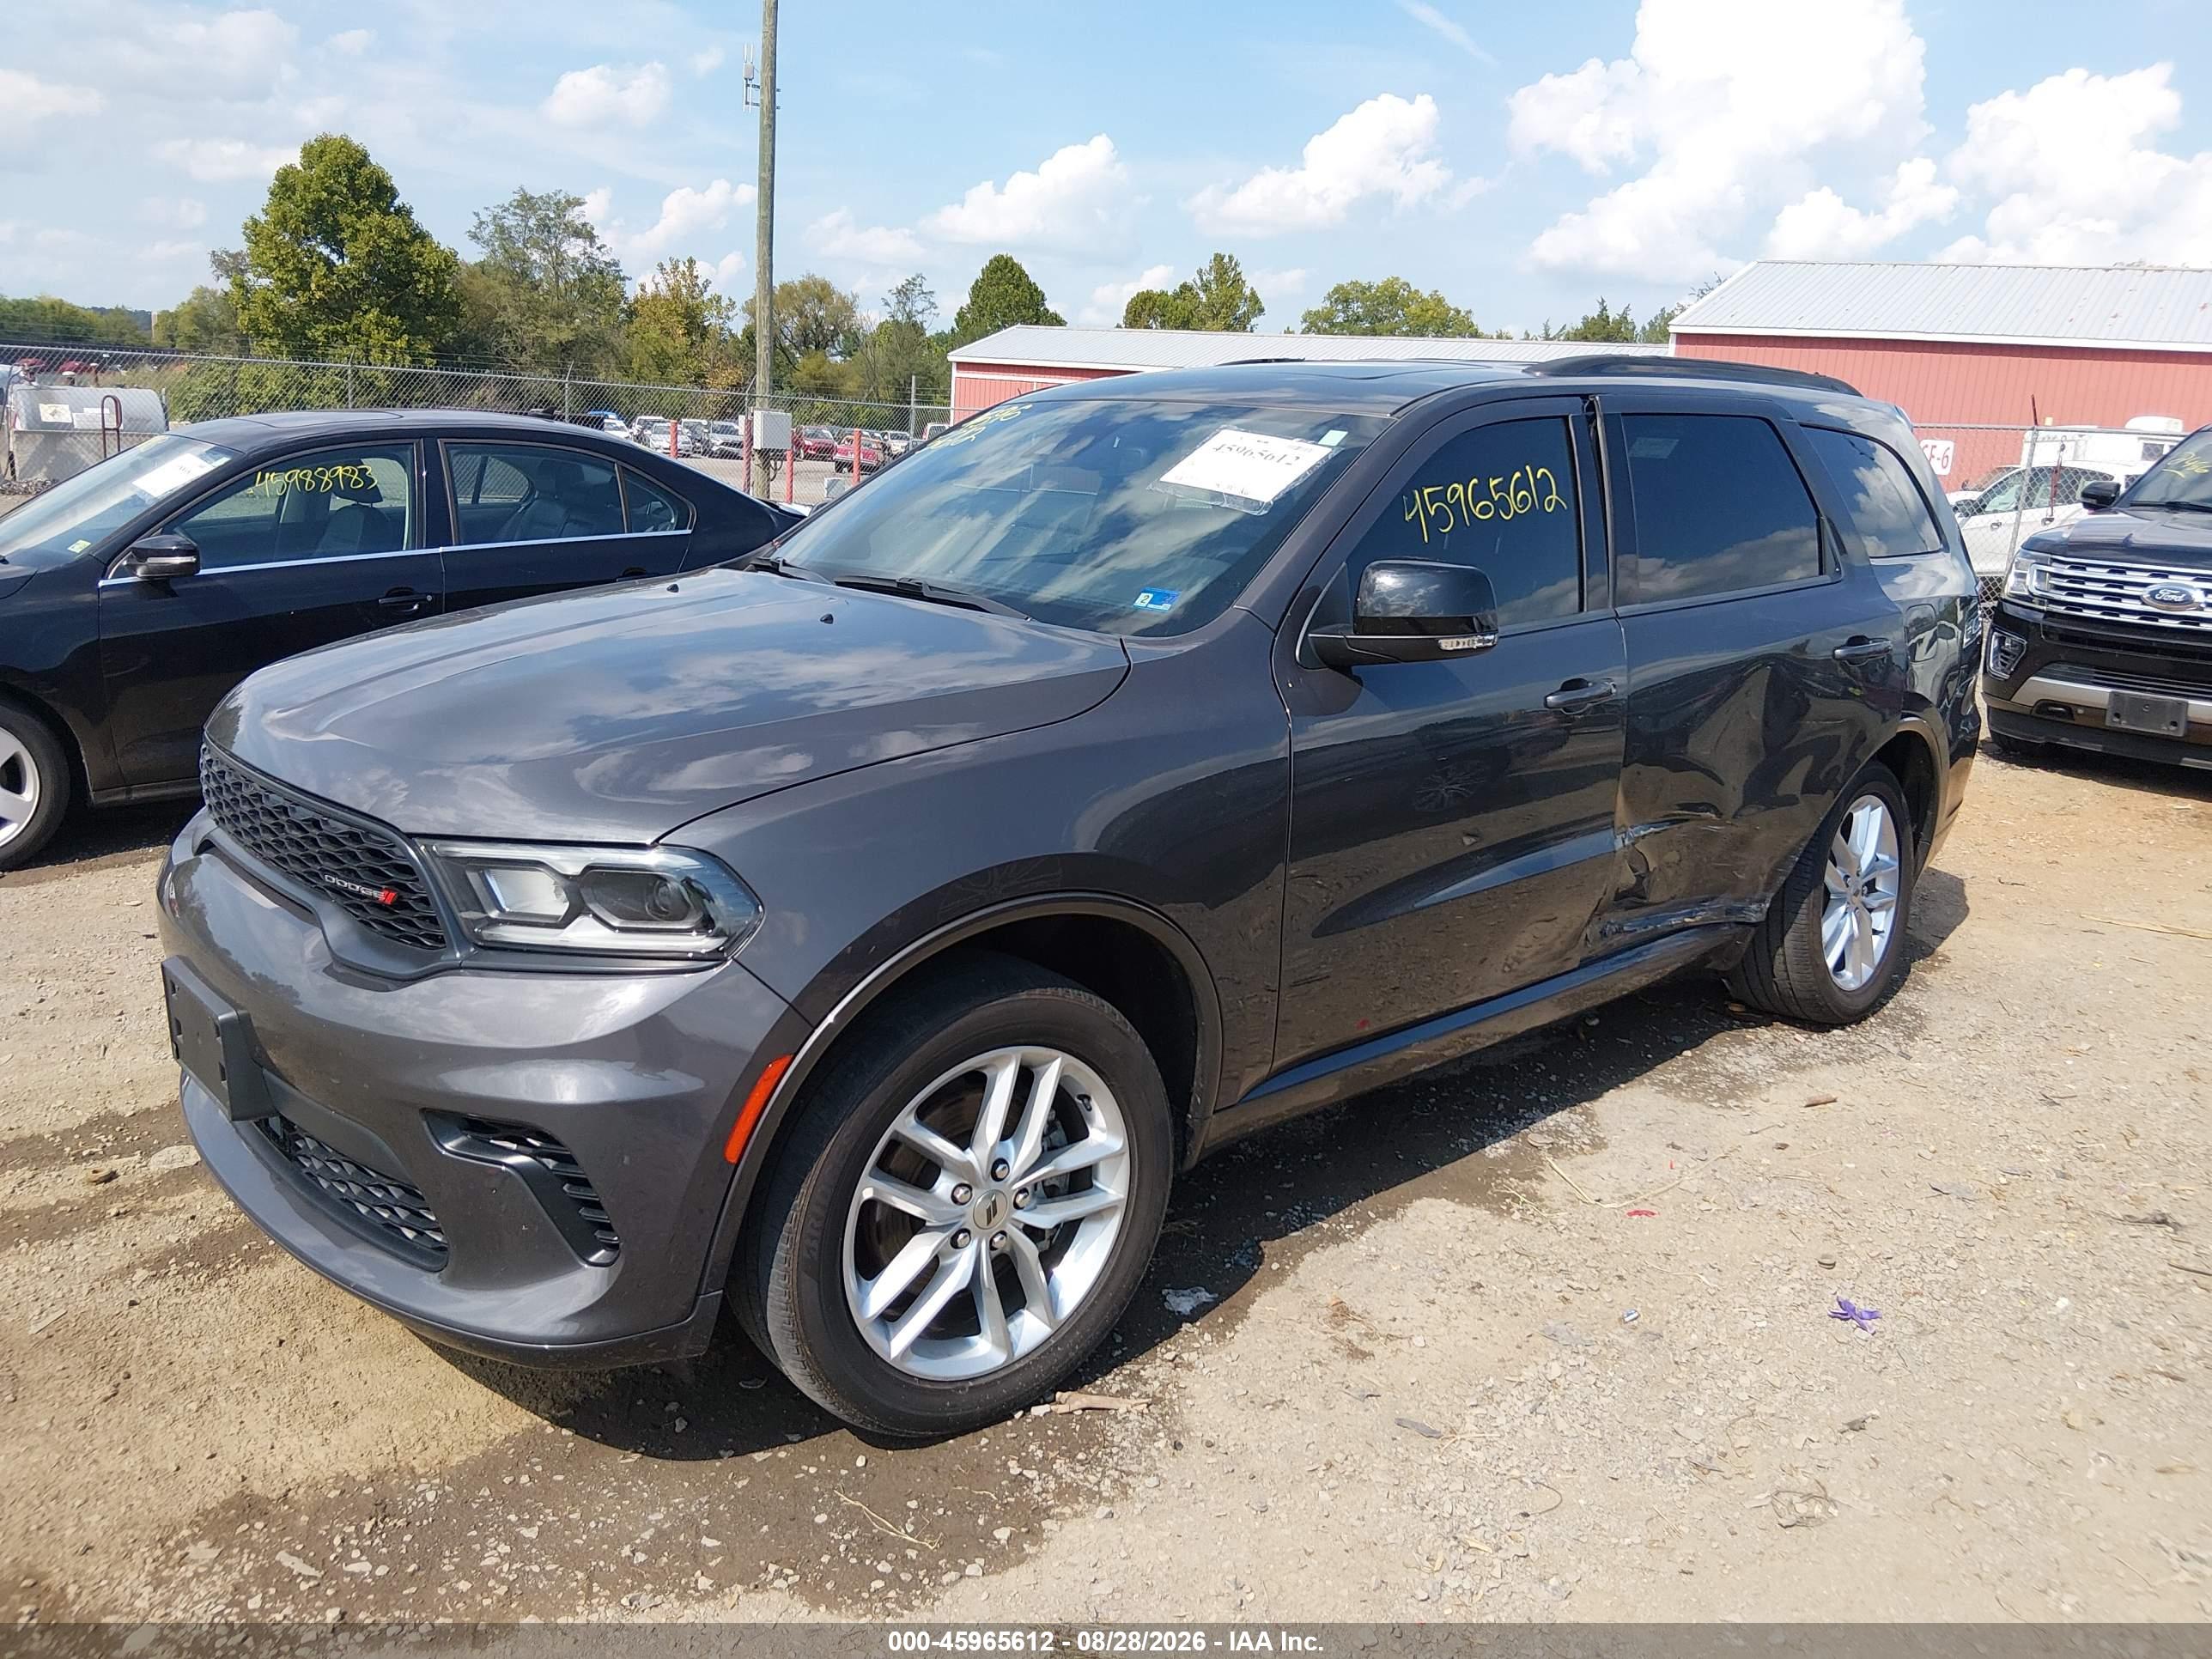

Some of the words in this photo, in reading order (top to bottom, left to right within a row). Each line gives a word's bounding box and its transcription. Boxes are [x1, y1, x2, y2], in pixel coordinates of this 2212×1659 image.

[255, 465, 379, 498] 45988983
[1401, 465, 1567, 544] 45965612
[2154, 588, 2187, 602] Ford
[325, 874, 386, 901] DODGE
